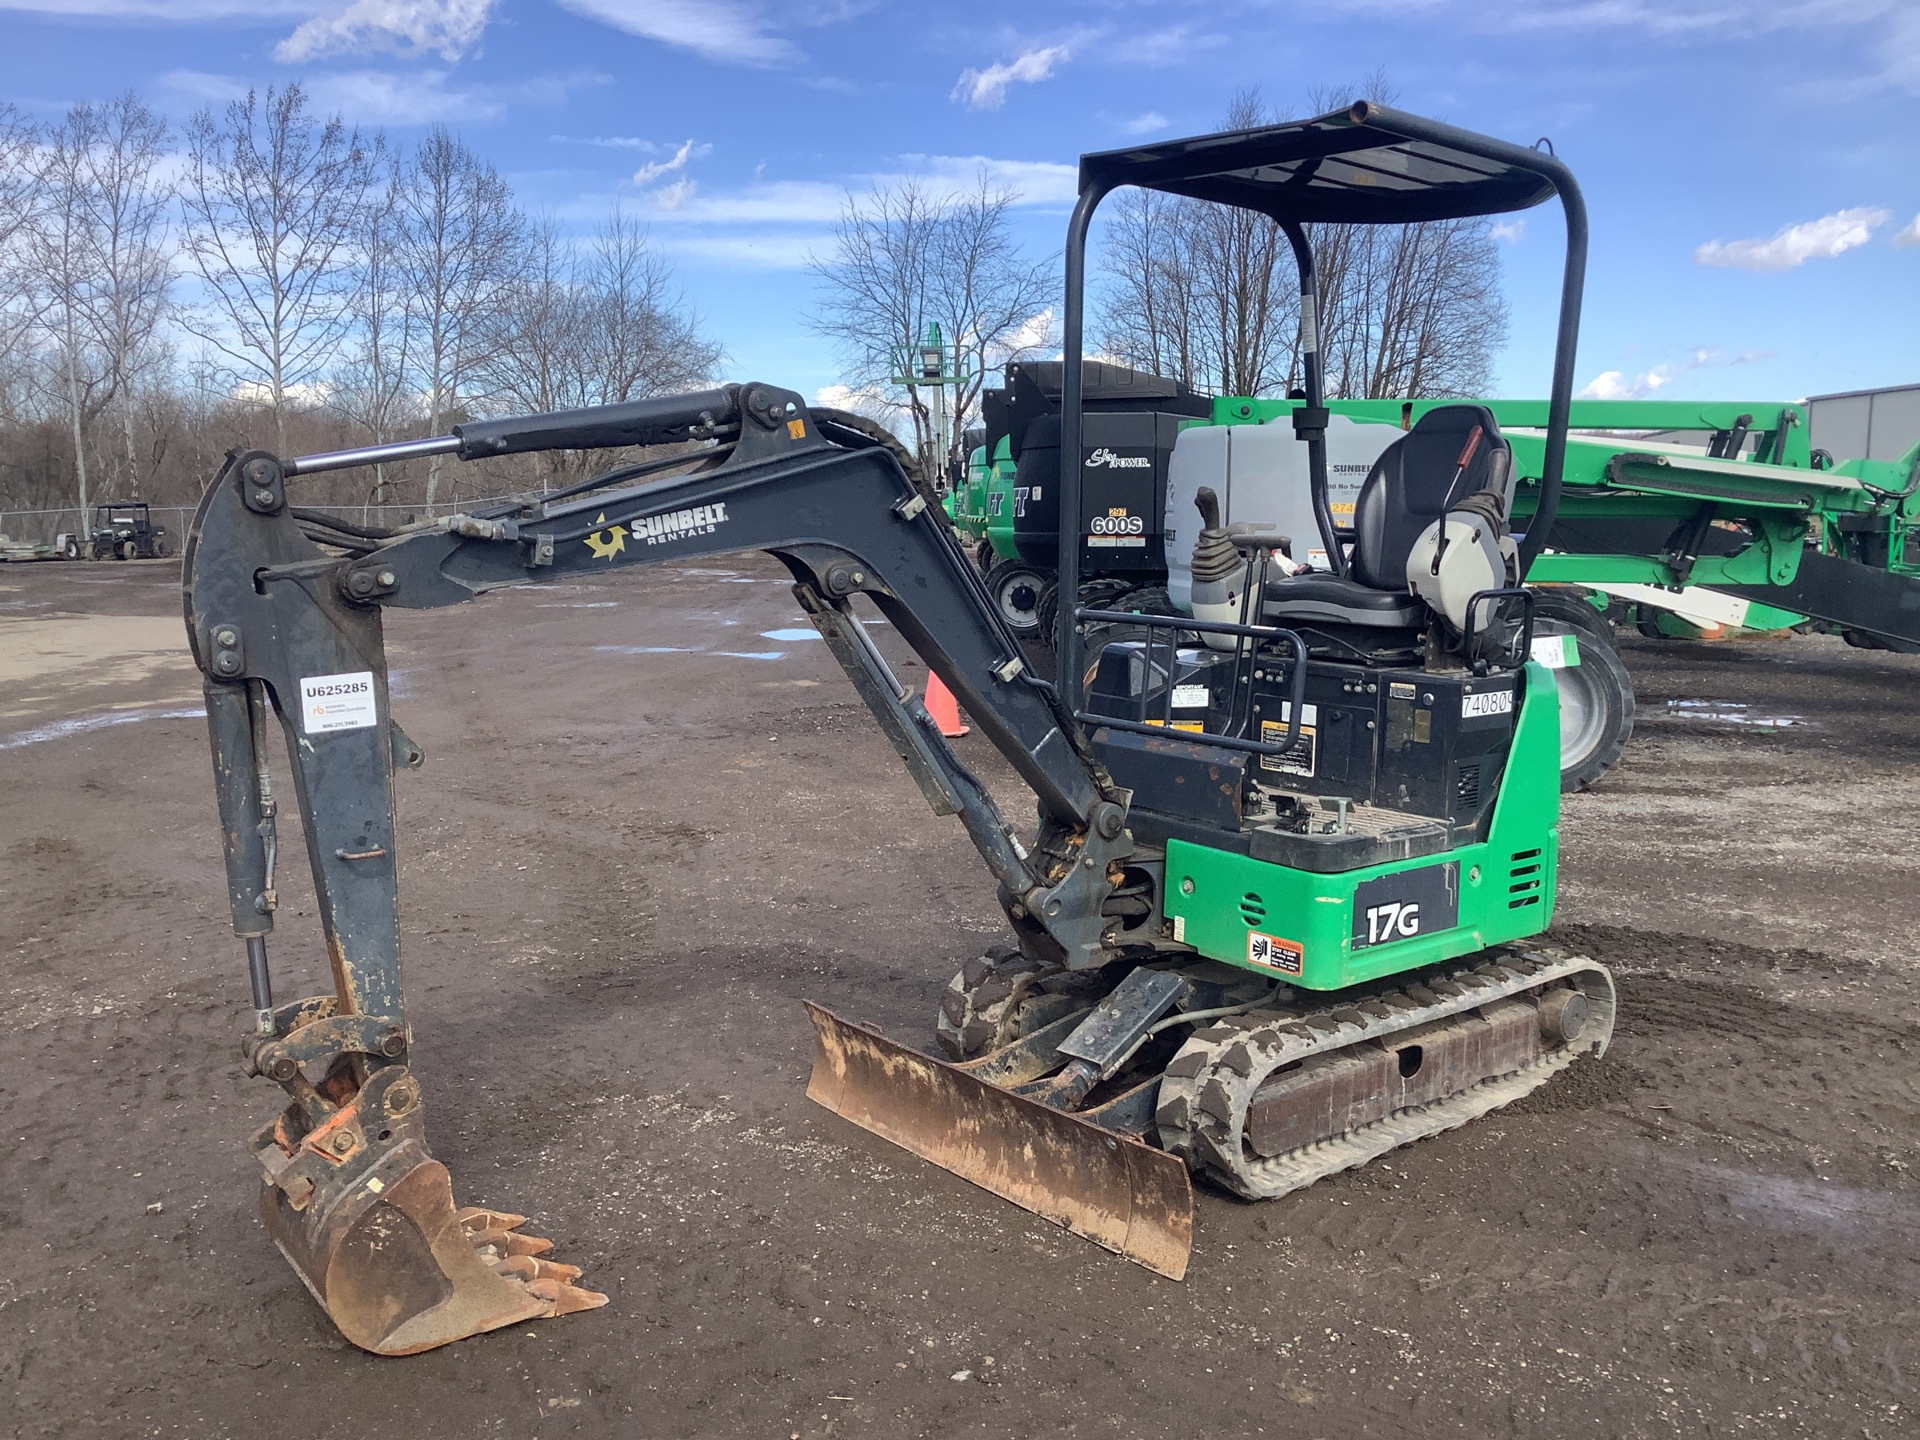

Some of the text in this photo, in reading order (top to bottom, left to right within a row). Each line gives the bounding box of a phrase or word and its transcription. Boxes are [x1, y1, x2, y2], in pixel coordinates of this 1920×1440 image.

[1110, 508, 1126, 516] 297
[1332, 503, 1353, 513] 274
[631, 502, 726, 540] SUNBELT
[1091, 516, 1143, 534] 600S
[647, 524, 716, 546] RENTALS
[306, 682, 368, 698] U625285
[313, 705, 325, 715] rb
[1367, 902, 1419, 944] 17G
[1277, 940, 1301, 951] WARNING
